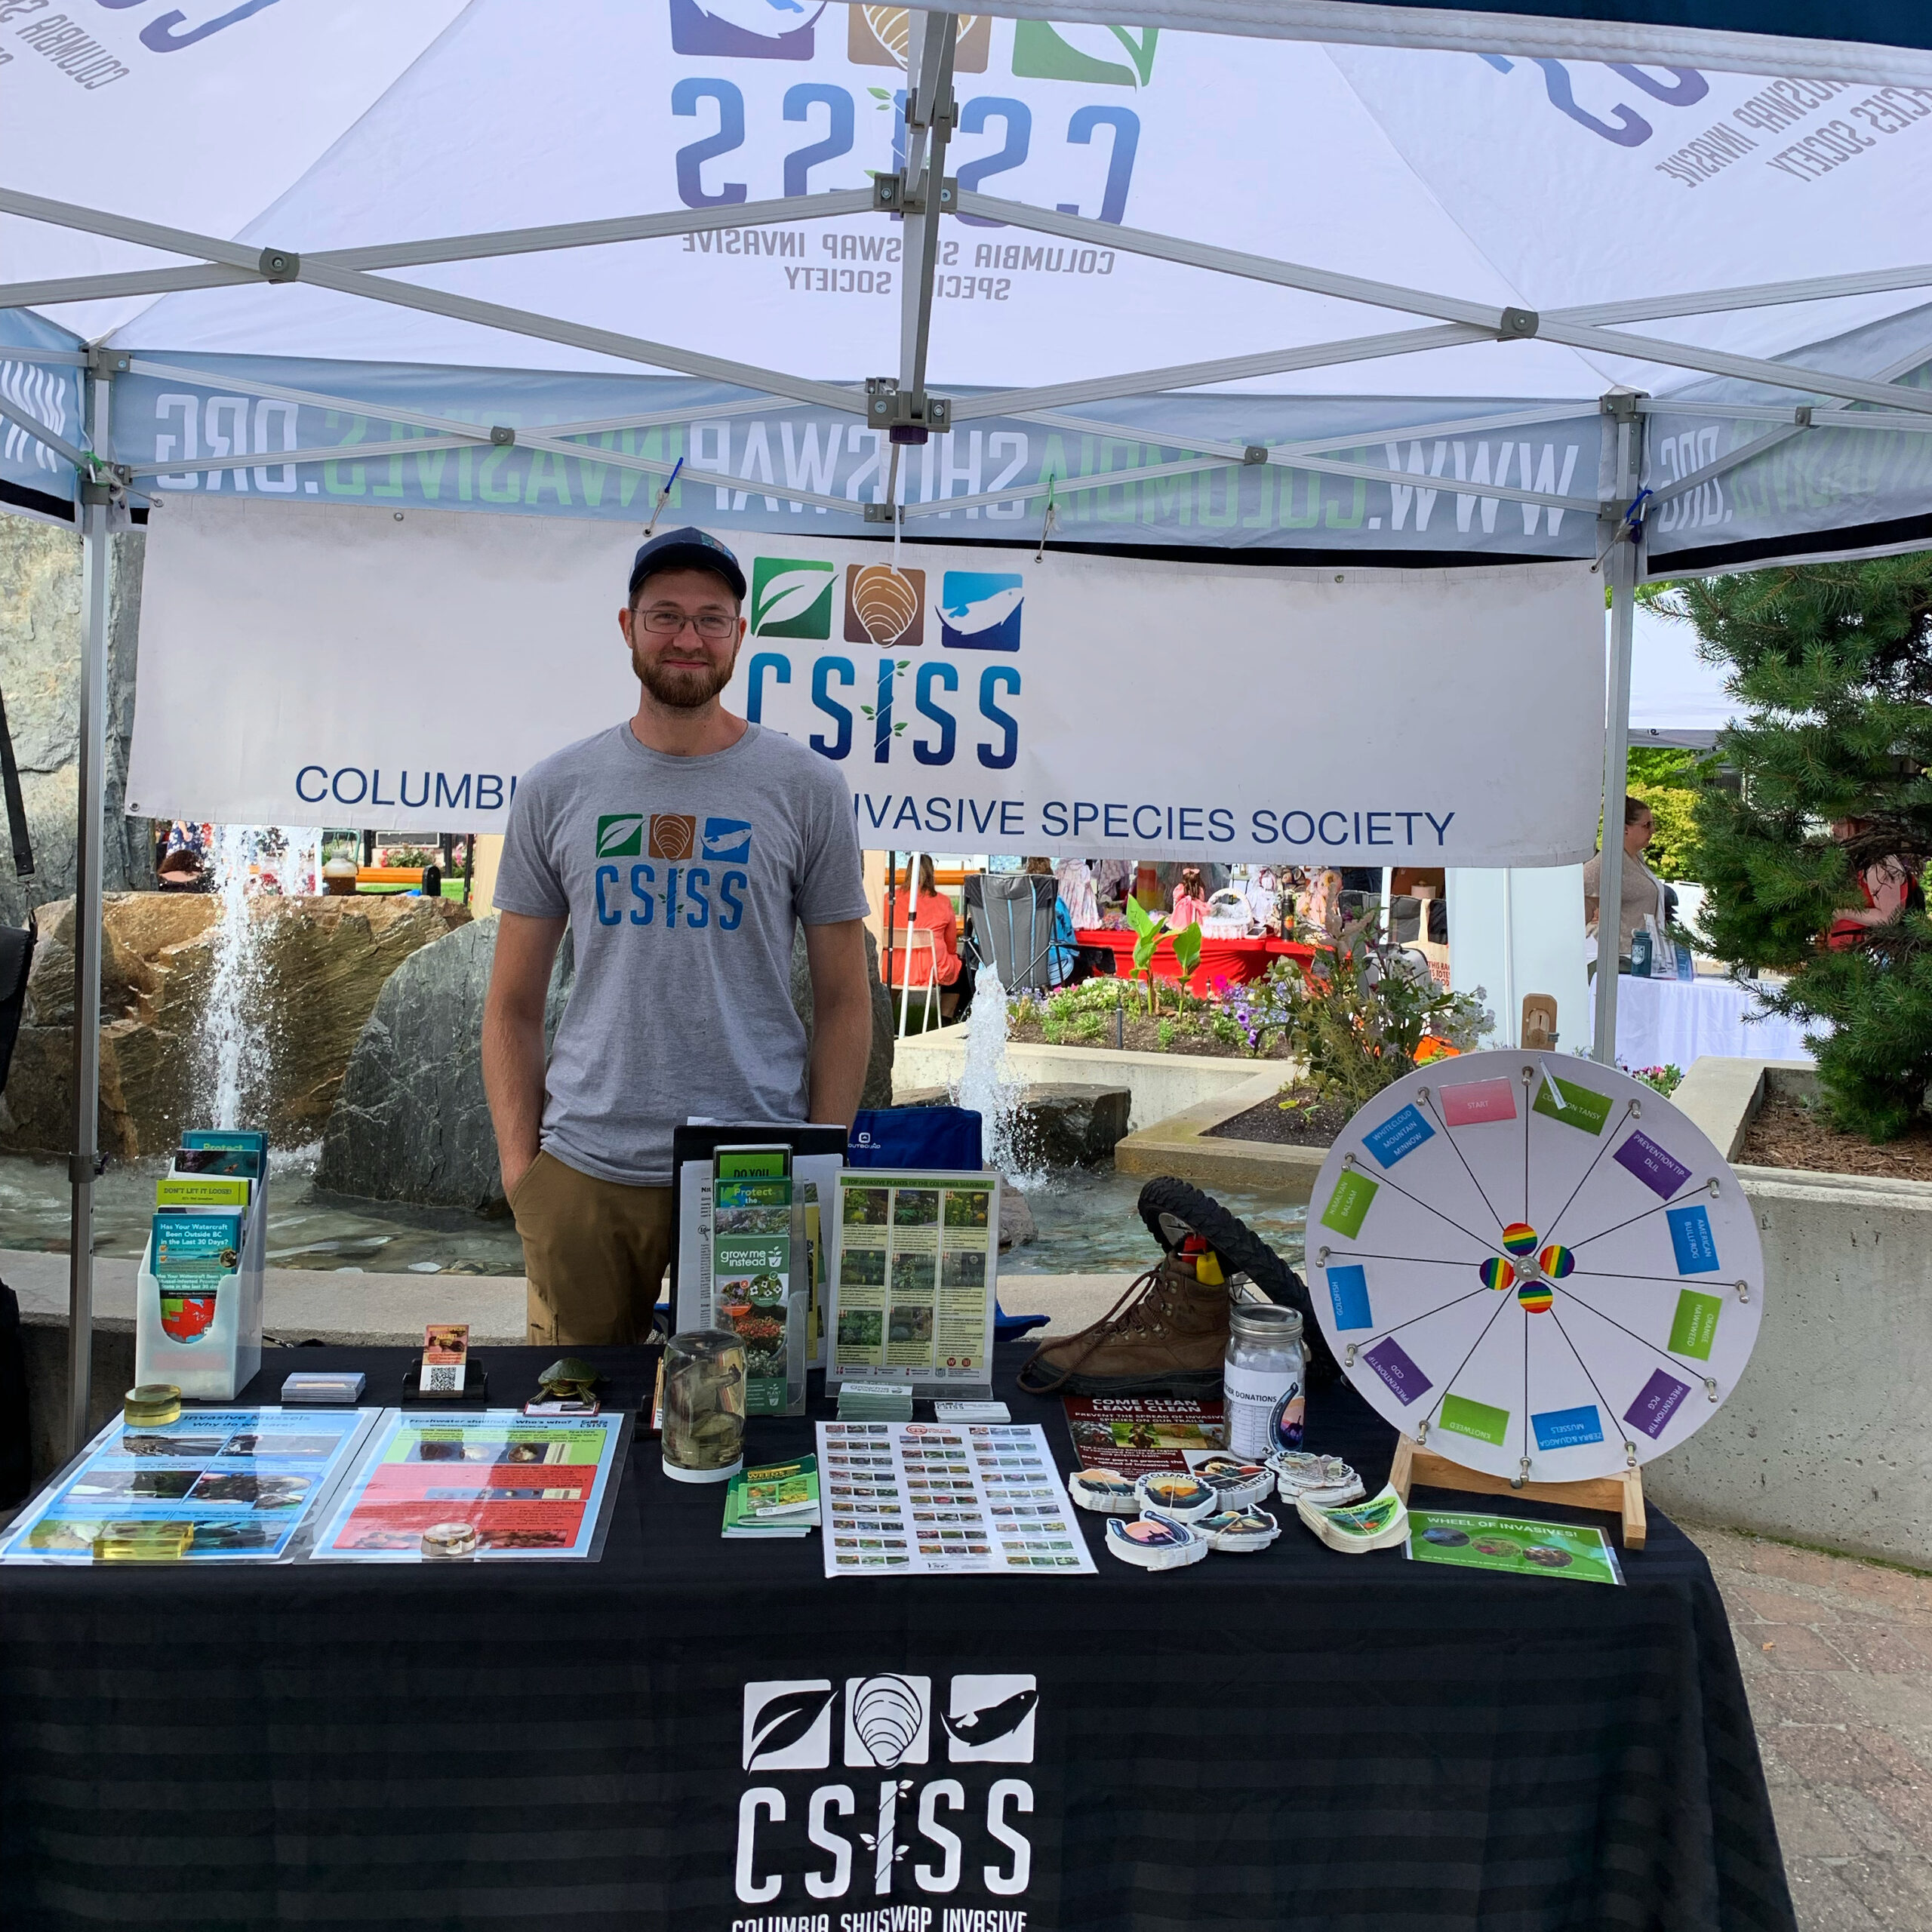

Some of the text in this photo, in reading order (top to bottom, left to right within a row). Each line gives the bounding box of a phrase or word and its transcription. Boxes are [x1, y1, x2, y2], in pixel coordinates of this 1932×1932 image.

[746, 652, 1021, 770] CSISS
[295, 764, 1456, 848] COLUMBI VASIVE SPECIES SOCIETY
[595, 863, 748, 931] CSISS
[1466, 1100, 1489, 1109] START
[1542, 1092, 1602, 1121] COON TANSY
[1372, 1109, 1412, 1142] WHITECLOUD
[1383, 1120, 1417, 1149] MOUNTAIN
[1393, 1132, 1423, 1156] MINNOW
[1633, 1134, 1674, 1168] PREVENTION
[734, 1169, 769, 1177] DO YOU
[1644, 1157, 1660, 1173] DLIL
[734, 1188, 773, 1196] Protect
[1340, 1189, 1357, 1217] BALSAM
[1684, 1220, 1700, 1260] BULLFROG
[1697, 1218, 1712, 1258] AMERICAN
[729, 1257, 766, 1266] instead
[1331, 1281, 1343, 1316] GOLDFISH
[1687, 1303, 1703, 1347] HAWKWEED
[1701, 1313, 1715, 1344] ORANGE
[1235, 1390, 1277, 1403] DONATIONS
[1376, 1362, 1410, 1403] PREVENTION
[1647, 1394, 1660, 1411] PCG
[1647, 1384, 1684, 1434] PREVENTION TIP
[1449, 1421, 1492, 1440] KNOTWEED
[1550, 1423, 1585, 1435] MUSSELS
[1579, 1432, 1603, 1444] ZEBRA
[1426, 1516, 1475, 1527] WHEEL
[1500, 1523, 1577, 1538] INVASIVES!
[735, 1778, 1035, 1904] CSISS
[840, 1905, 933, 1932] SHUSWAP
[943, 1908, 1028, 1932] INVASIVE
